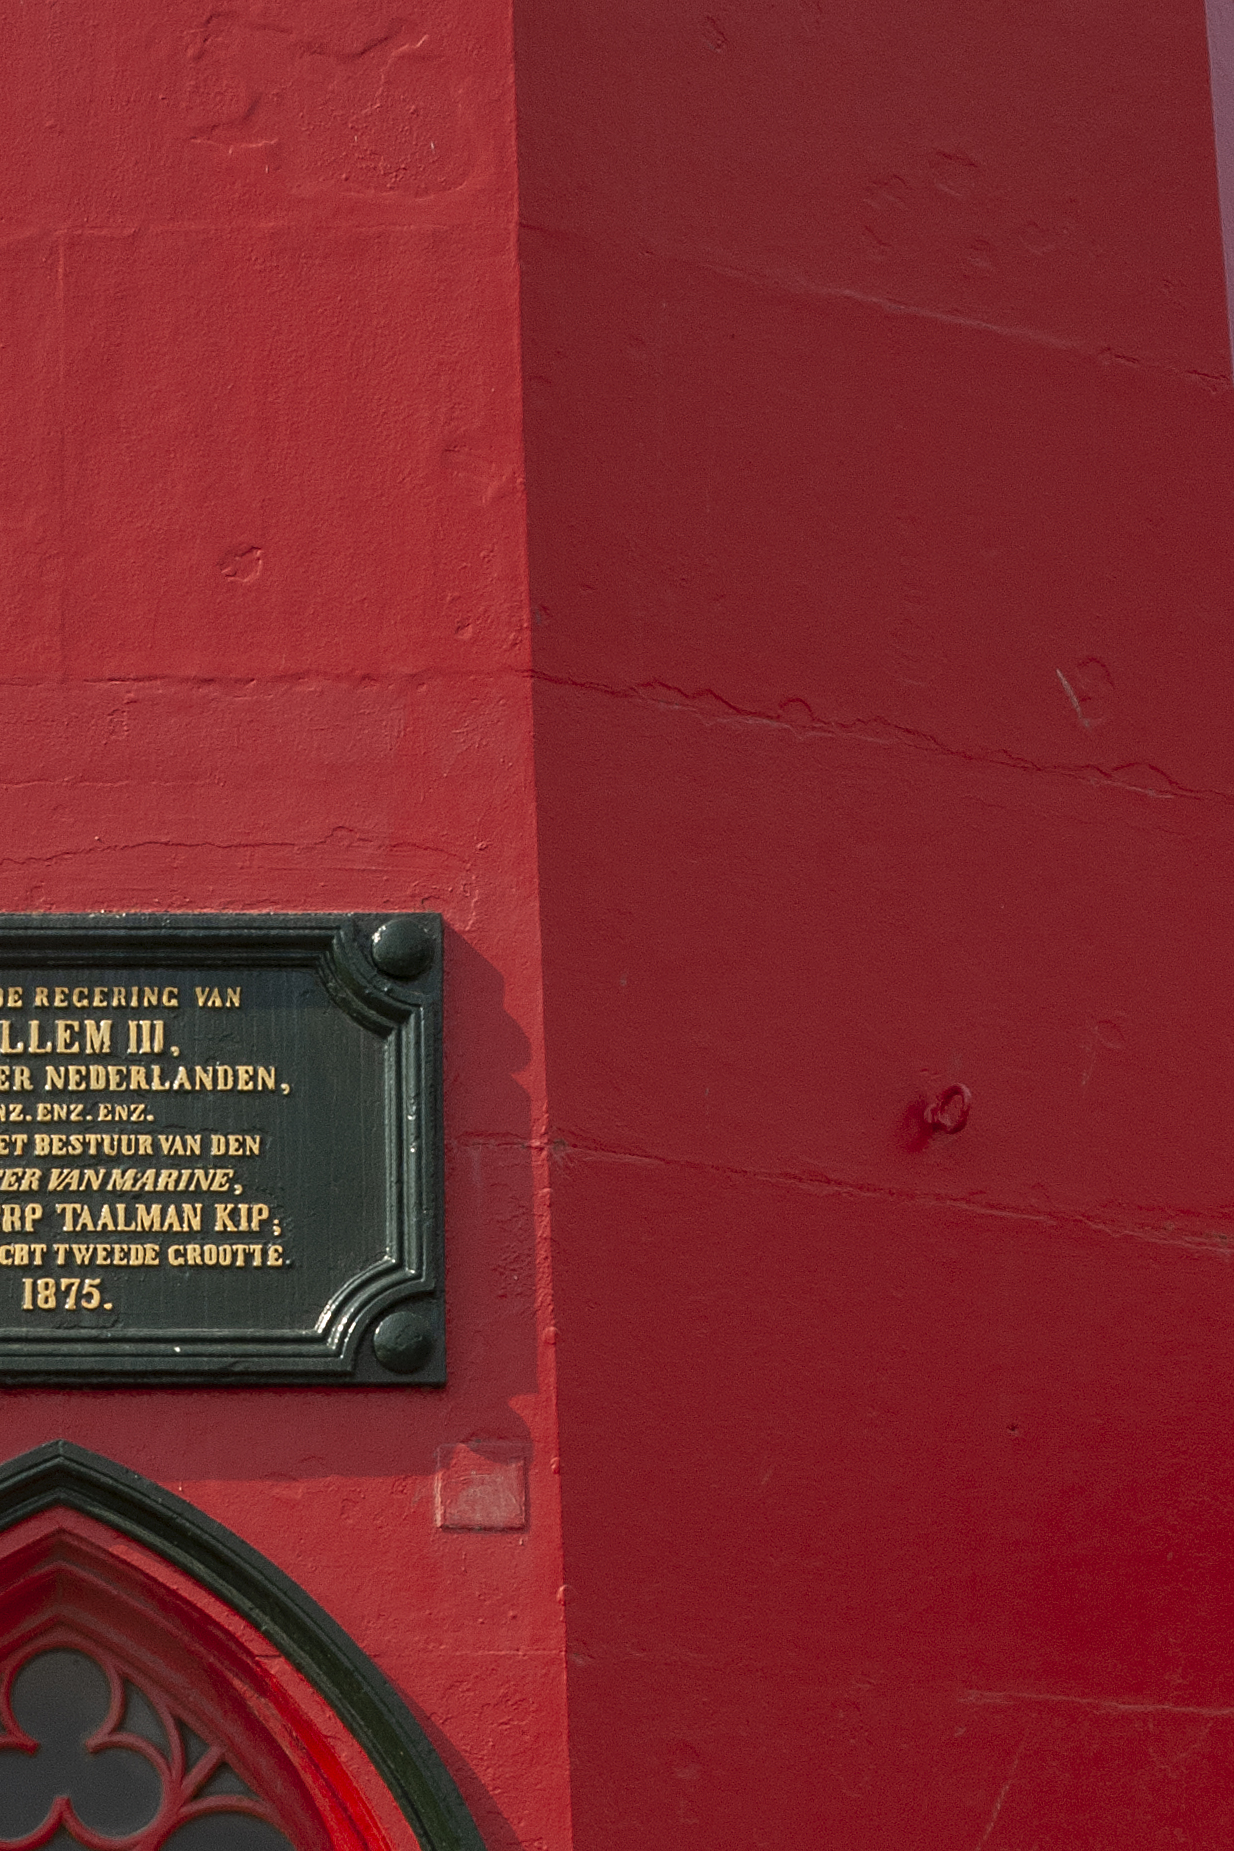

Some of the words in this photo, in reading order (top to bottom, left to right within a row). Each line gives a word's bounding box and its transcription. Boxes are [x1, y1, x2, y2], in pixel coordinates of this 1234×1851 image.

[34, 987, 179, 1008] REGERING
[195, 986, 241, 1008] VAN
[127, 1019, 180, 1057] III,
[44, 1064, 291, 1095] NEDERLANDEN,
[36, 1103, 93, 1122] ENZ.
[97, 1103, 155, 1122] ENZ.
[33, 1134, 154, 1156] BESTUUR
[157, 1134, 202, 1156] VAN
[210, 1134, 261, 1156] DEN
[47, 1168, 107, 1191] VAN
[106, 1168, 244, 1195] MARINE,
[55, 1203, 203, 1232] TAALMAN
[214, 1203, 282, 1236] KIP;
[53, 1244, 160, 1266] TWEEDE
[21, 1277, 114, 1310] 1875.
